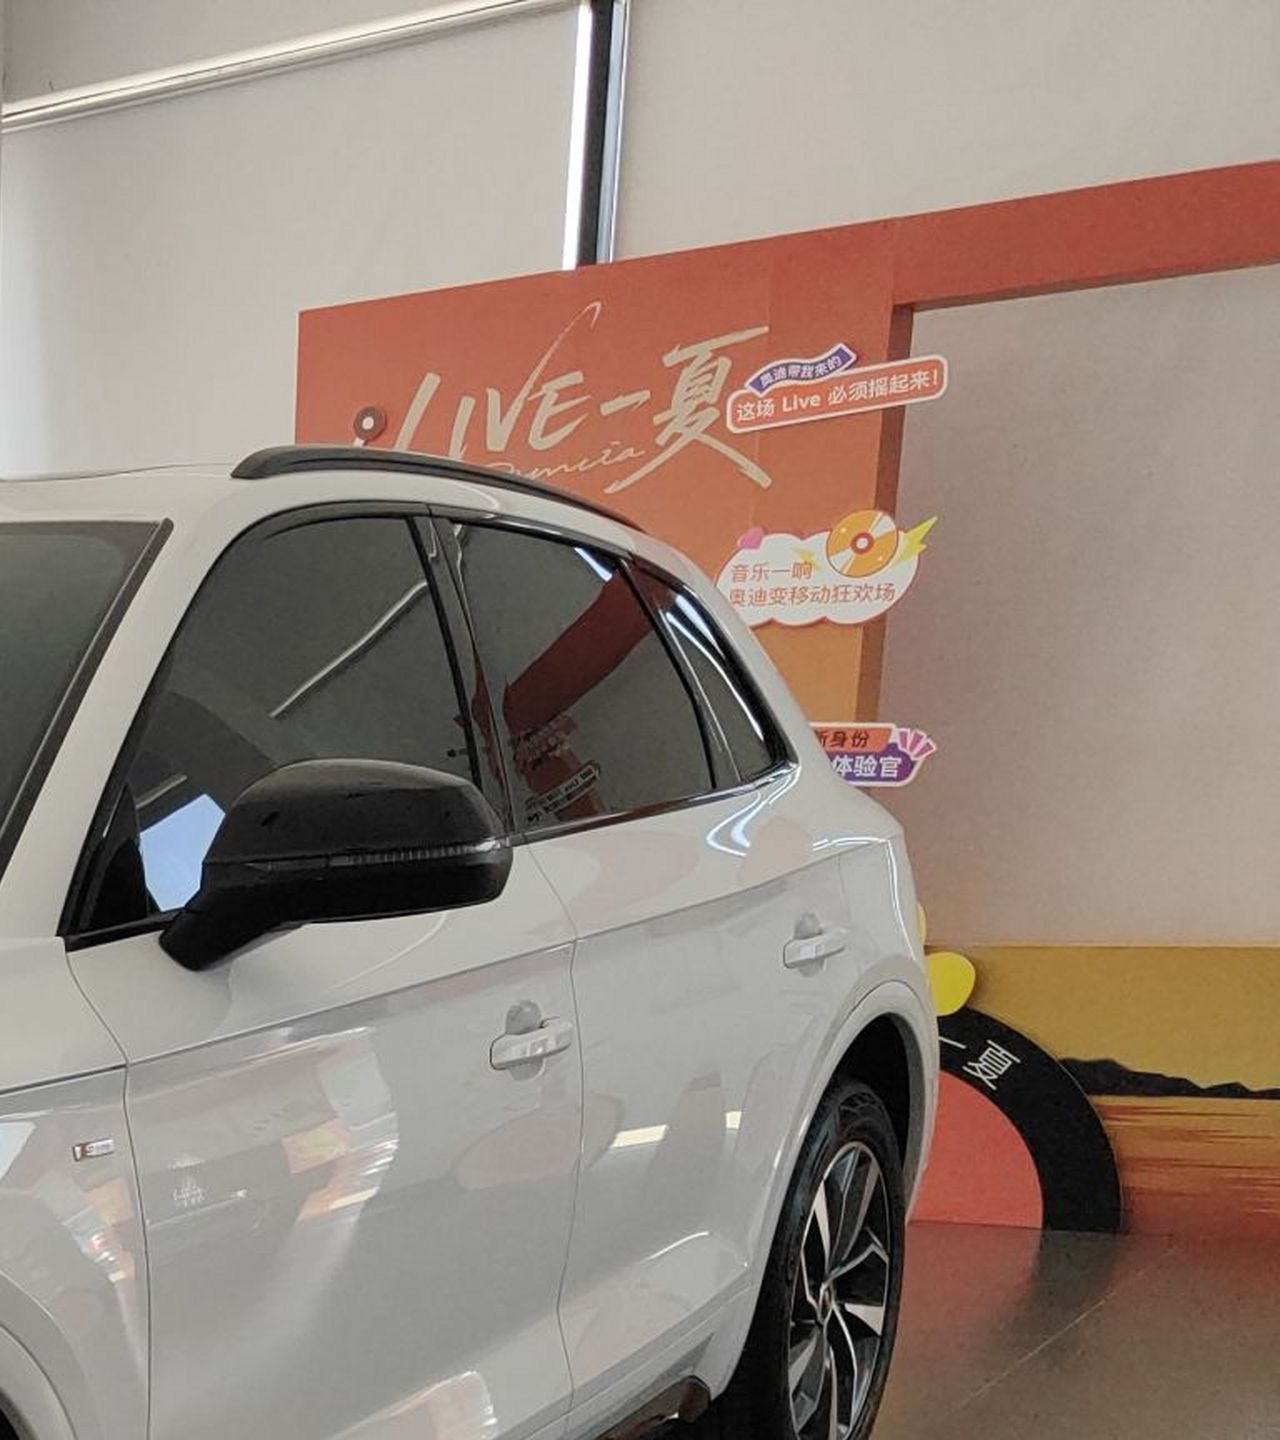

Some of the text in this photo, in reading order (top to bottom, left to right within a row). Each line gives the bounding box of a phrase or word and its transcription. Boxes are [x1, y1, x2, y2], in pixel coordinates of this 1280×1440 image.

[737, 400, 775, 423] 这场
[782, 394, 821, 413] Live
[730, 562, 813, 583] 音乐一响
[729, 583, 896, 608] 奥迪变移动狂欢场
